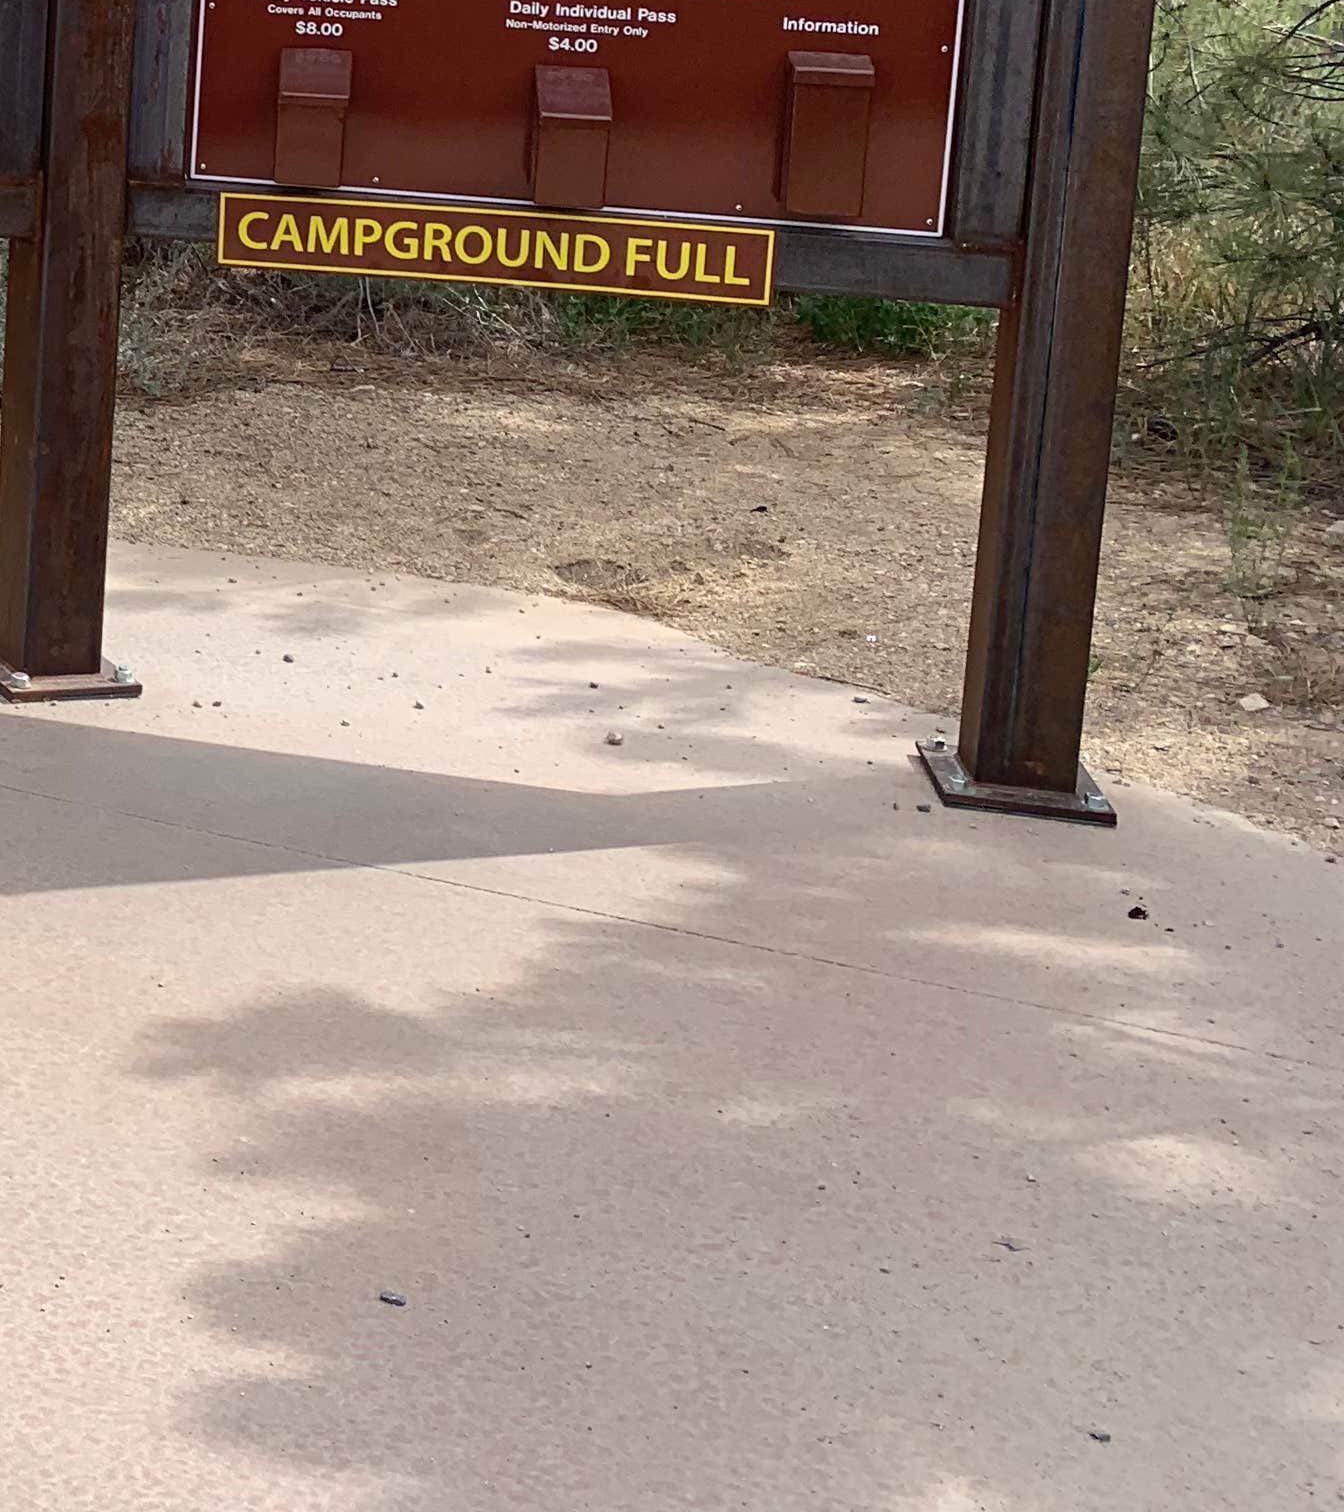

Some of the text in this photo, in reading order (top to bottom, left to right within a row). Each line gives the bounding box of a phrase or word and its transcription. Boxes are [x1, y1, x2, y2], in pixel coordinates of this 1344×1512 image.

[267, 4, 382, 20] Covers All Occupants
[510, 0, 676, 23] Daily Individual Pass
[296, 21, 343, 36] $8.00
[506, 19, 648, 38] Non-Motorized Entry Only
[783, 17, 879, 35] Information
[548, 37, 598, 52] $4.00
[238, 212, 750, 285] CAMPGROUND FULL
